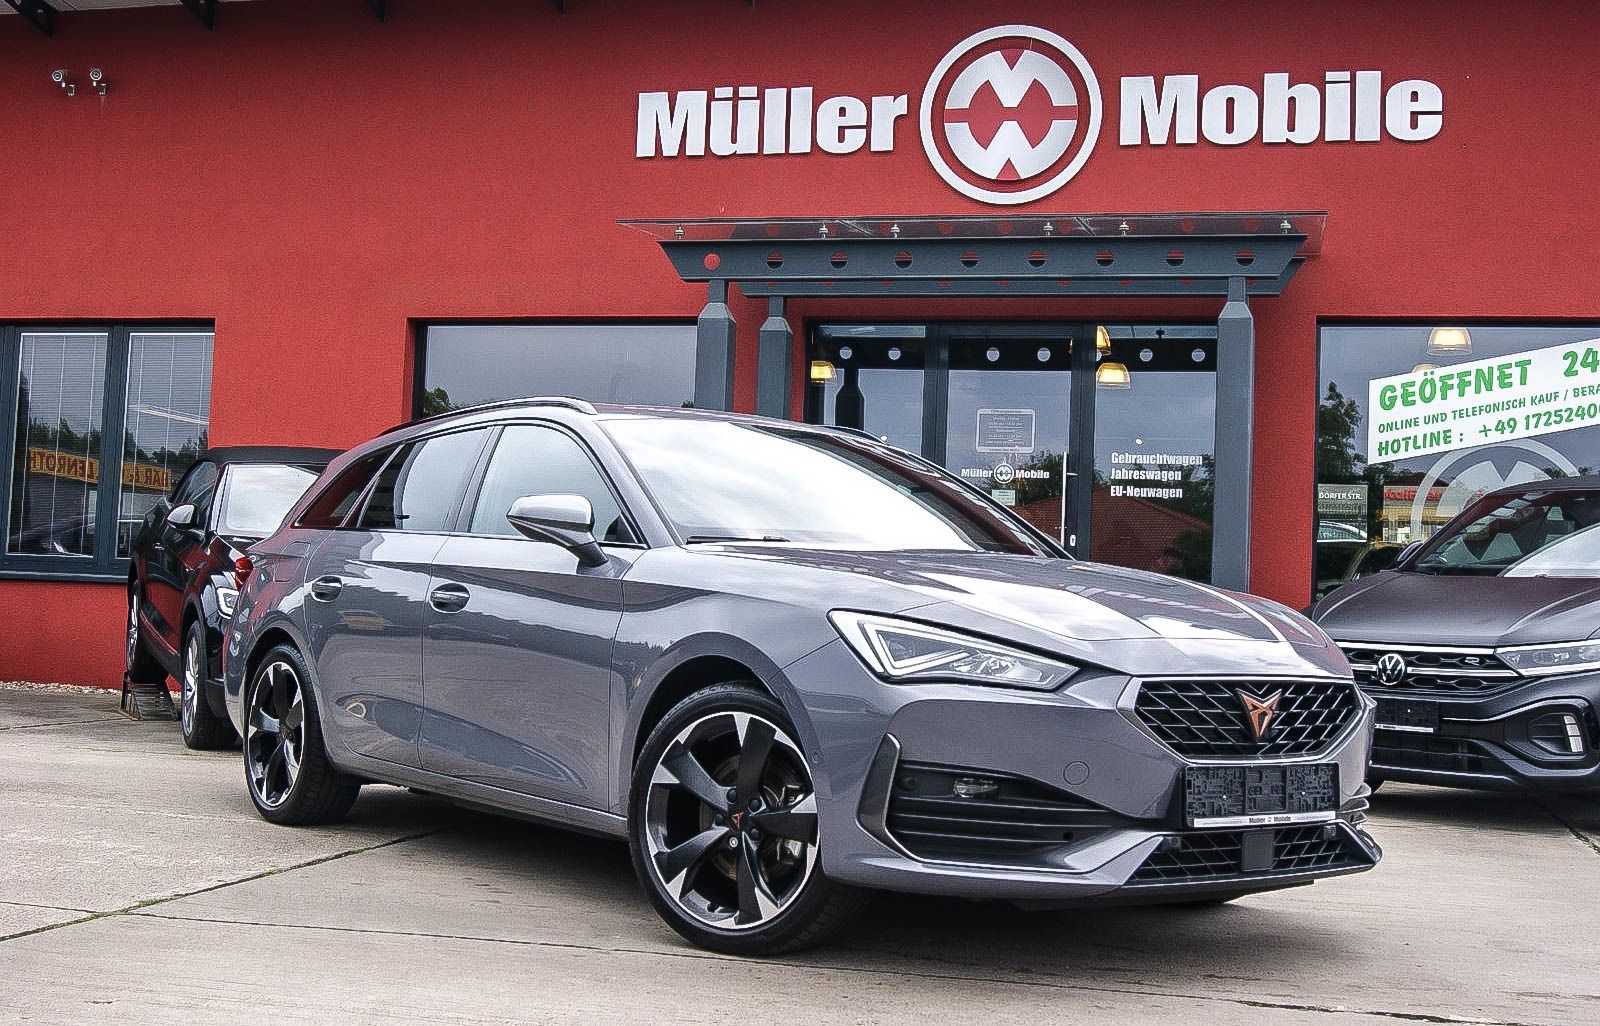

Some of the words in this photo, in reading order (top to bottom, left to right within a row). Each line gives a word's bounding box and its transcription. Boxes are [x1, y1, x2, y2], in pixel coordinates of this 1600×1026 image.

[636, 86, 908, 158] Müller
[1119, 70, 1443, 146] Mobile
[1379, 359, 1532, 411] GEÖFFNET
[1562, 348, 1600, 378] 24
[1378, 416, 1420, 434] ONLINE
[1423, 412, 1448, 426] UND
[1451, 397, 1526, 421] TELEFONISCH
[1530, 391, 1560, 406] KAUF
[1378, 429, 1452, 456] HOTLINE
[1478, 418, 1518, 438] +49
[1524, 403, 1600, 431] 1725240
[1111, 452, 1203, 466] Gebrauchtwagen
[961, 468, 993, 478] Müller
[1015, 470, 1050, 479] Mobile
[1110, 468, 1182, 482] Jahreswagen
[1110, 485, 1183, 499] EU-Neuwagen
